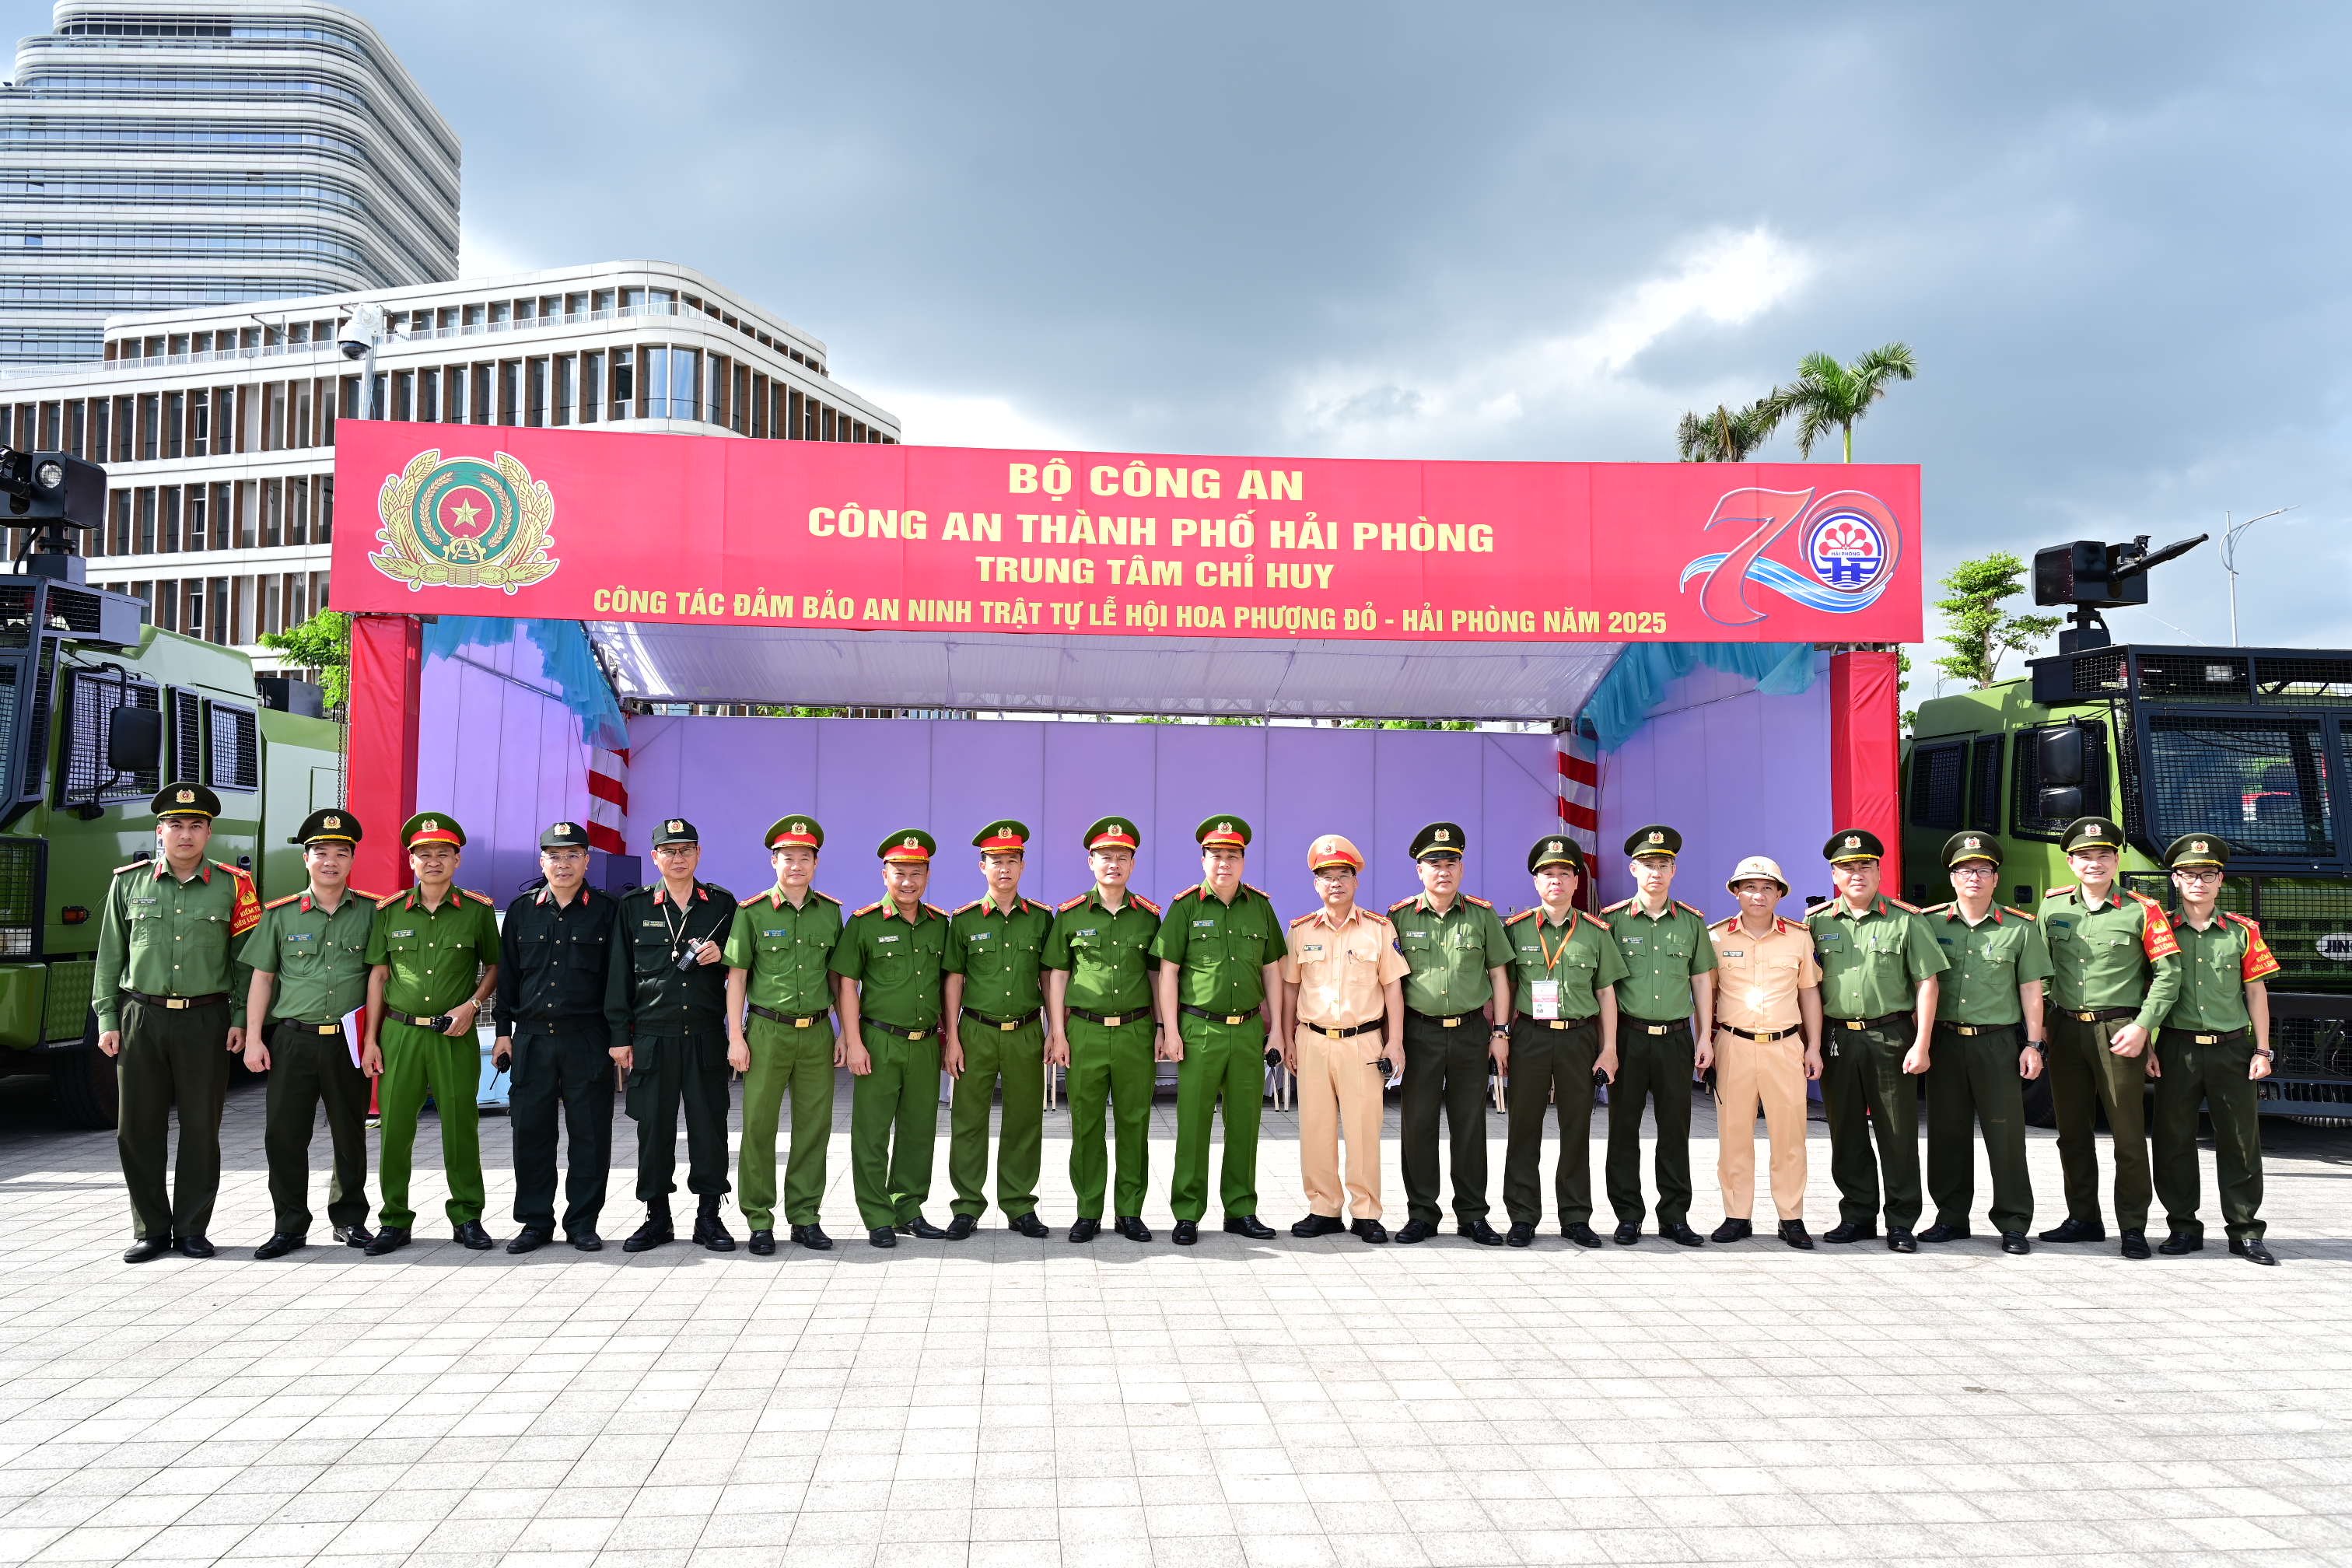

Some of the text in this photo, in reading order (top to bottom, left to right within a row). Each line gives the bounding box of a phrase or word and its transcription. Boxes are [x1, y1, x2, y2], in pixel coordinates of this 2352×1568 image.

[1009, 457, 1304, 502] BỘ CÔNG AN
[808, 502, 1494, 553] CÔNG AN THÀNH PHỐ HẢI PHÒNG
[975, 553, 1335, 590] TRUNG TÂM CHỈ HUY
[593, 584, 667, 613] CÔNG
[675, 586, 725, 615] TÁC
[733, 587, 794, 618] ĐẢM
[802, 588, 855, 620] BẢO
[862, 597, 899, 621] AN
[908, 599, 972, 623] NINH
[980, 597, 1043, 629] TRẬT
[1049, 600, 1084, 631] TỰ
[1089, 594, 1118, 626] LỄ
[1125, 600, 1168, 632] HỘI
[1176, 605, 1227, 628] HOA
[1234, 604, 1337, 635] PHƯỢNG
[1342, 601, 1378, 632] ĐỎ
[1402, 600, 1444, 632] HẢI
[1451, 604, 1538, 633] PHÒNG
[1543, 606, 1601, 634] NĂM
[1608, 611, 1668, 634] 2025
[2324, 940, 2352, 953] JIN
